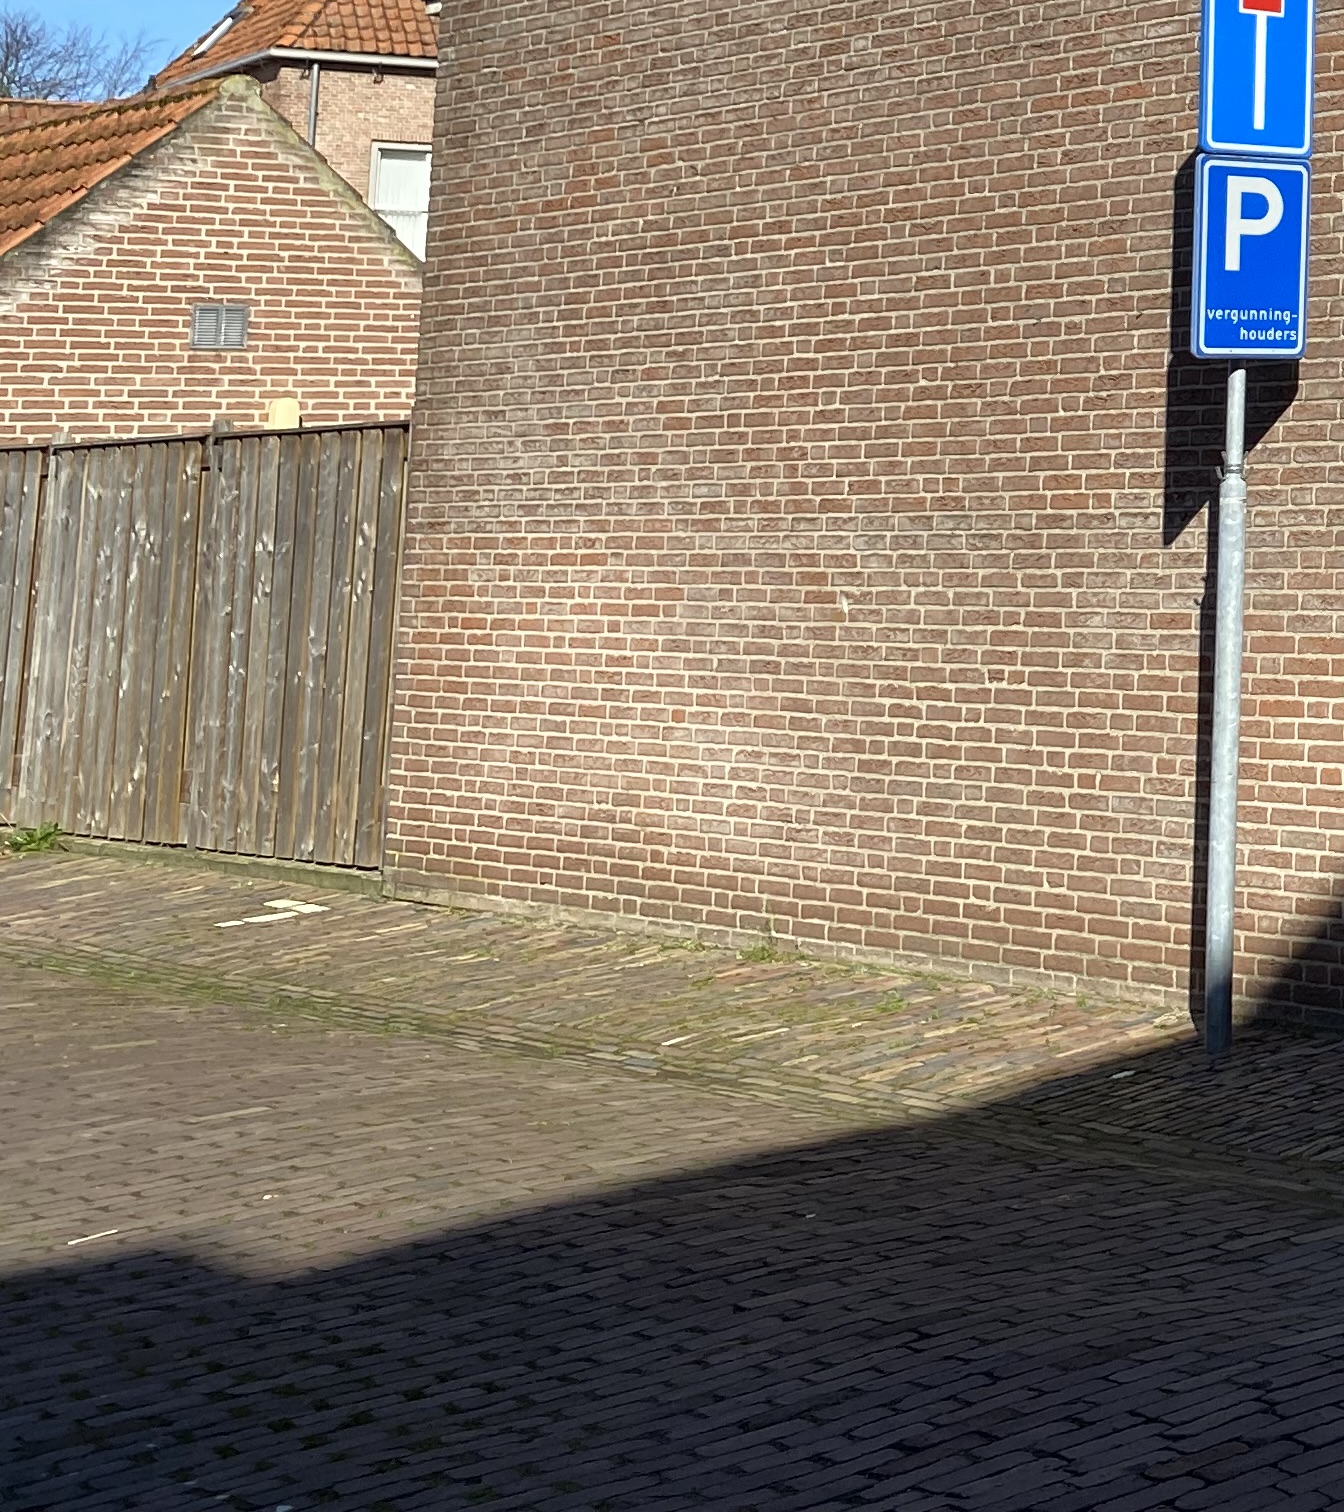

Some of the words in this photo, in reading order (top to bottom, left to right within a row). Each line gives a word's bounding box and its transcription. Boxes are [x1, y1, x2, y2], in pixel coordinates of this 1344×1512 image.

[1225, 175, 1284, 271] P
[1206, 307, 1298, 326] vergunning-
[1239, 326, 1297, 341] houders
